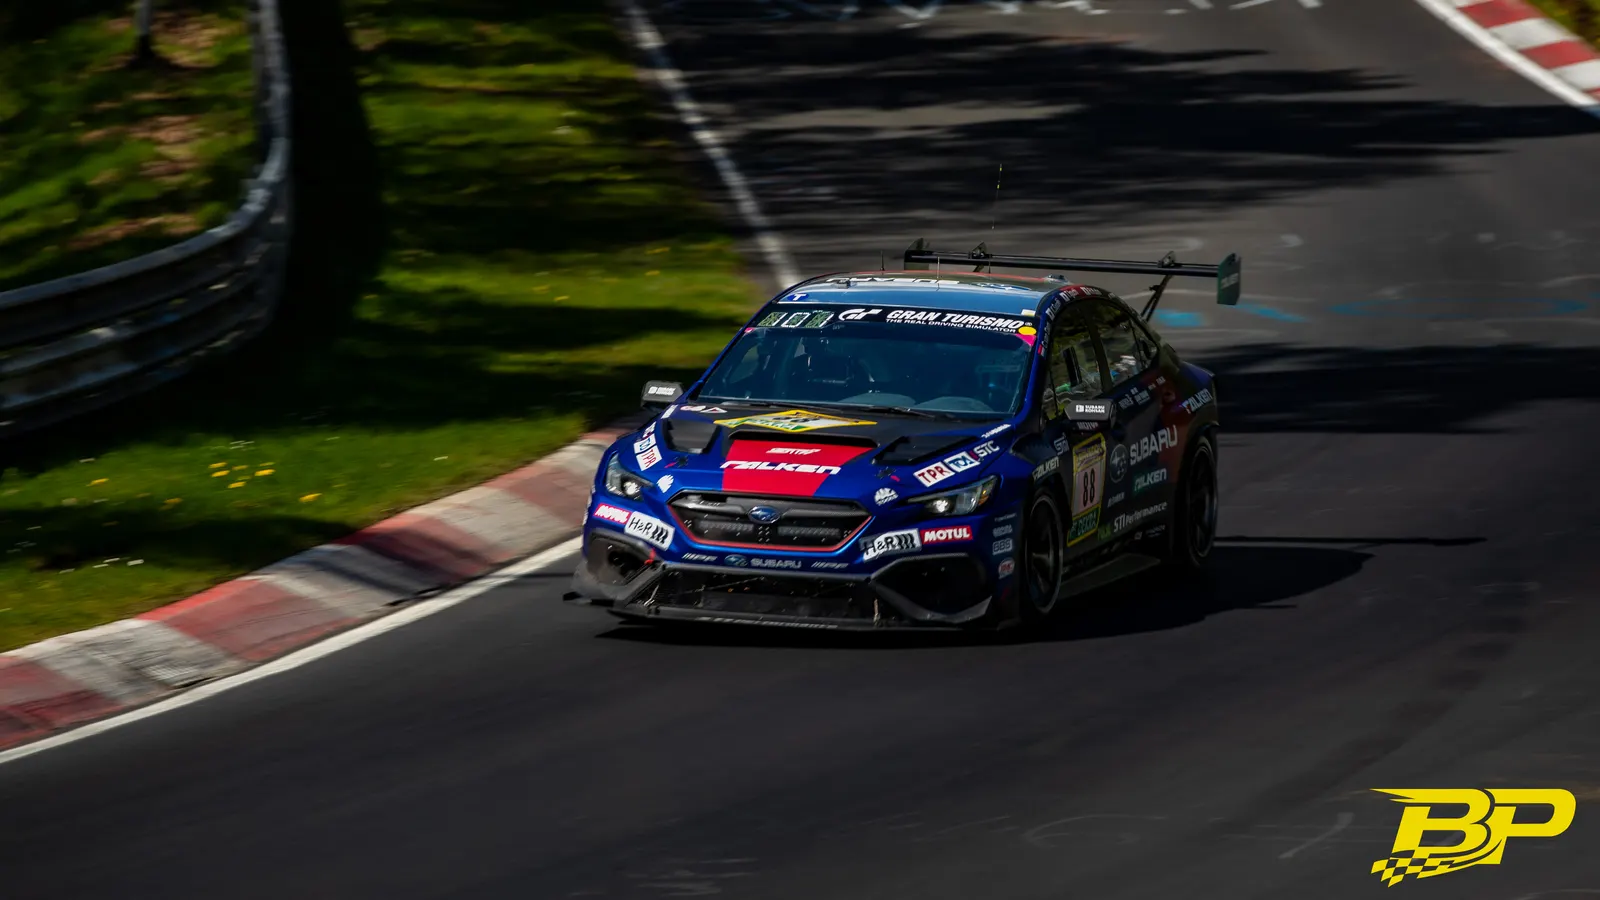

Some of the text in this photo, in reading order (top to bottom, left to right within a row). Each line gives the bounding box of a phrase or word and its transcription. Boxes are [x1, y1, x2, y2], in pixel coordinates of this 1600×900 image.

[887, 309, 1024, 329] GRAN TURISMO
[965, 325, 1017, 333] SIMULATOR
[973, 440, 1000, 458] STC
[1129, 424, 1178, 466] SUBARU
[719, 460, 842, 476] FALKEN
[917, 465, 948, 484] TPR
[1082, 468, 1097, 508] 88
[923, 527, 971, 543] MOTUL
[750, 557, 803, 569] SUBARU
